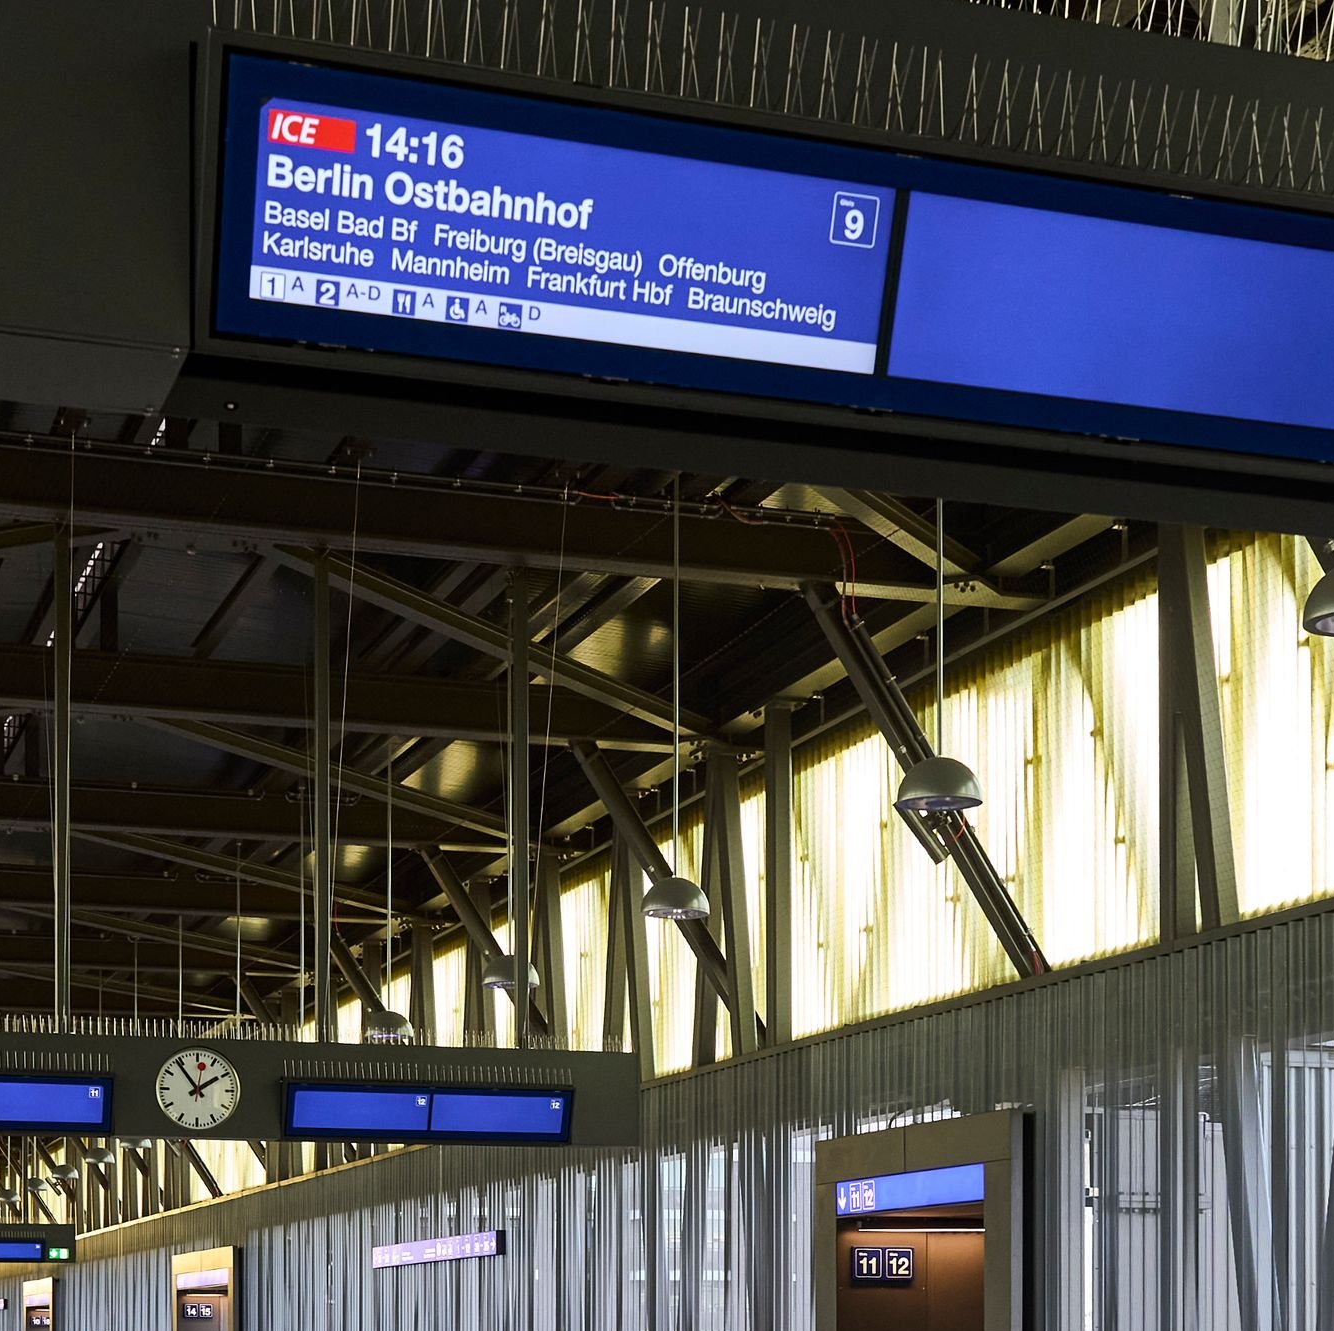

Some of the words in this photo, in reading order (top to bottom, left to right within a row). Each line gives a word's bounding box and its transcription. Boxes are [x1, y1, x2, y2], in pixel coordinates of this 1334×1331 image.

[270, 113, 320, 145] ICE
[365, 122, 465, 169] 14:16
[267, 154, 374, 200] Berlin
[384, 171, 594, 230] Ostbahnhof
[844, 209, 865, 241] 9
[264, 200, 330, 231] Basel
[337, 210, 384, 239] Bad
[390, 217, 419, 242] Bf
[433, 223, 527, 263] Freiburg
[533, 237, 643, 278] (Breisgau)
[658, 253, 767, 295] Offenburg
[262, 230, 375, 267] Karlsruhe
[390, 248, 510, 285] Mannheim
[526, 266, 627, 302] Frankfurt
[632, 279, 673, 306] Hbf
[687, 287, 837, 333] Braunschweig
[291, 276, 305, 292] A
[319, 281, 336, 305] 2
[346, 283, 381, 301] A-D
[421, 293, 435, 309] A
[474, 301, 488, 316] A
[528, 306, 542, 321] D
[417, 1097, 426, 1105] 12
[551, 1101, 561, 1109] 12
[859, 1256, 878, 1275] 11
[889, 1256, 910, 1275] 12
[186, 1307, 197, 1316] 14
